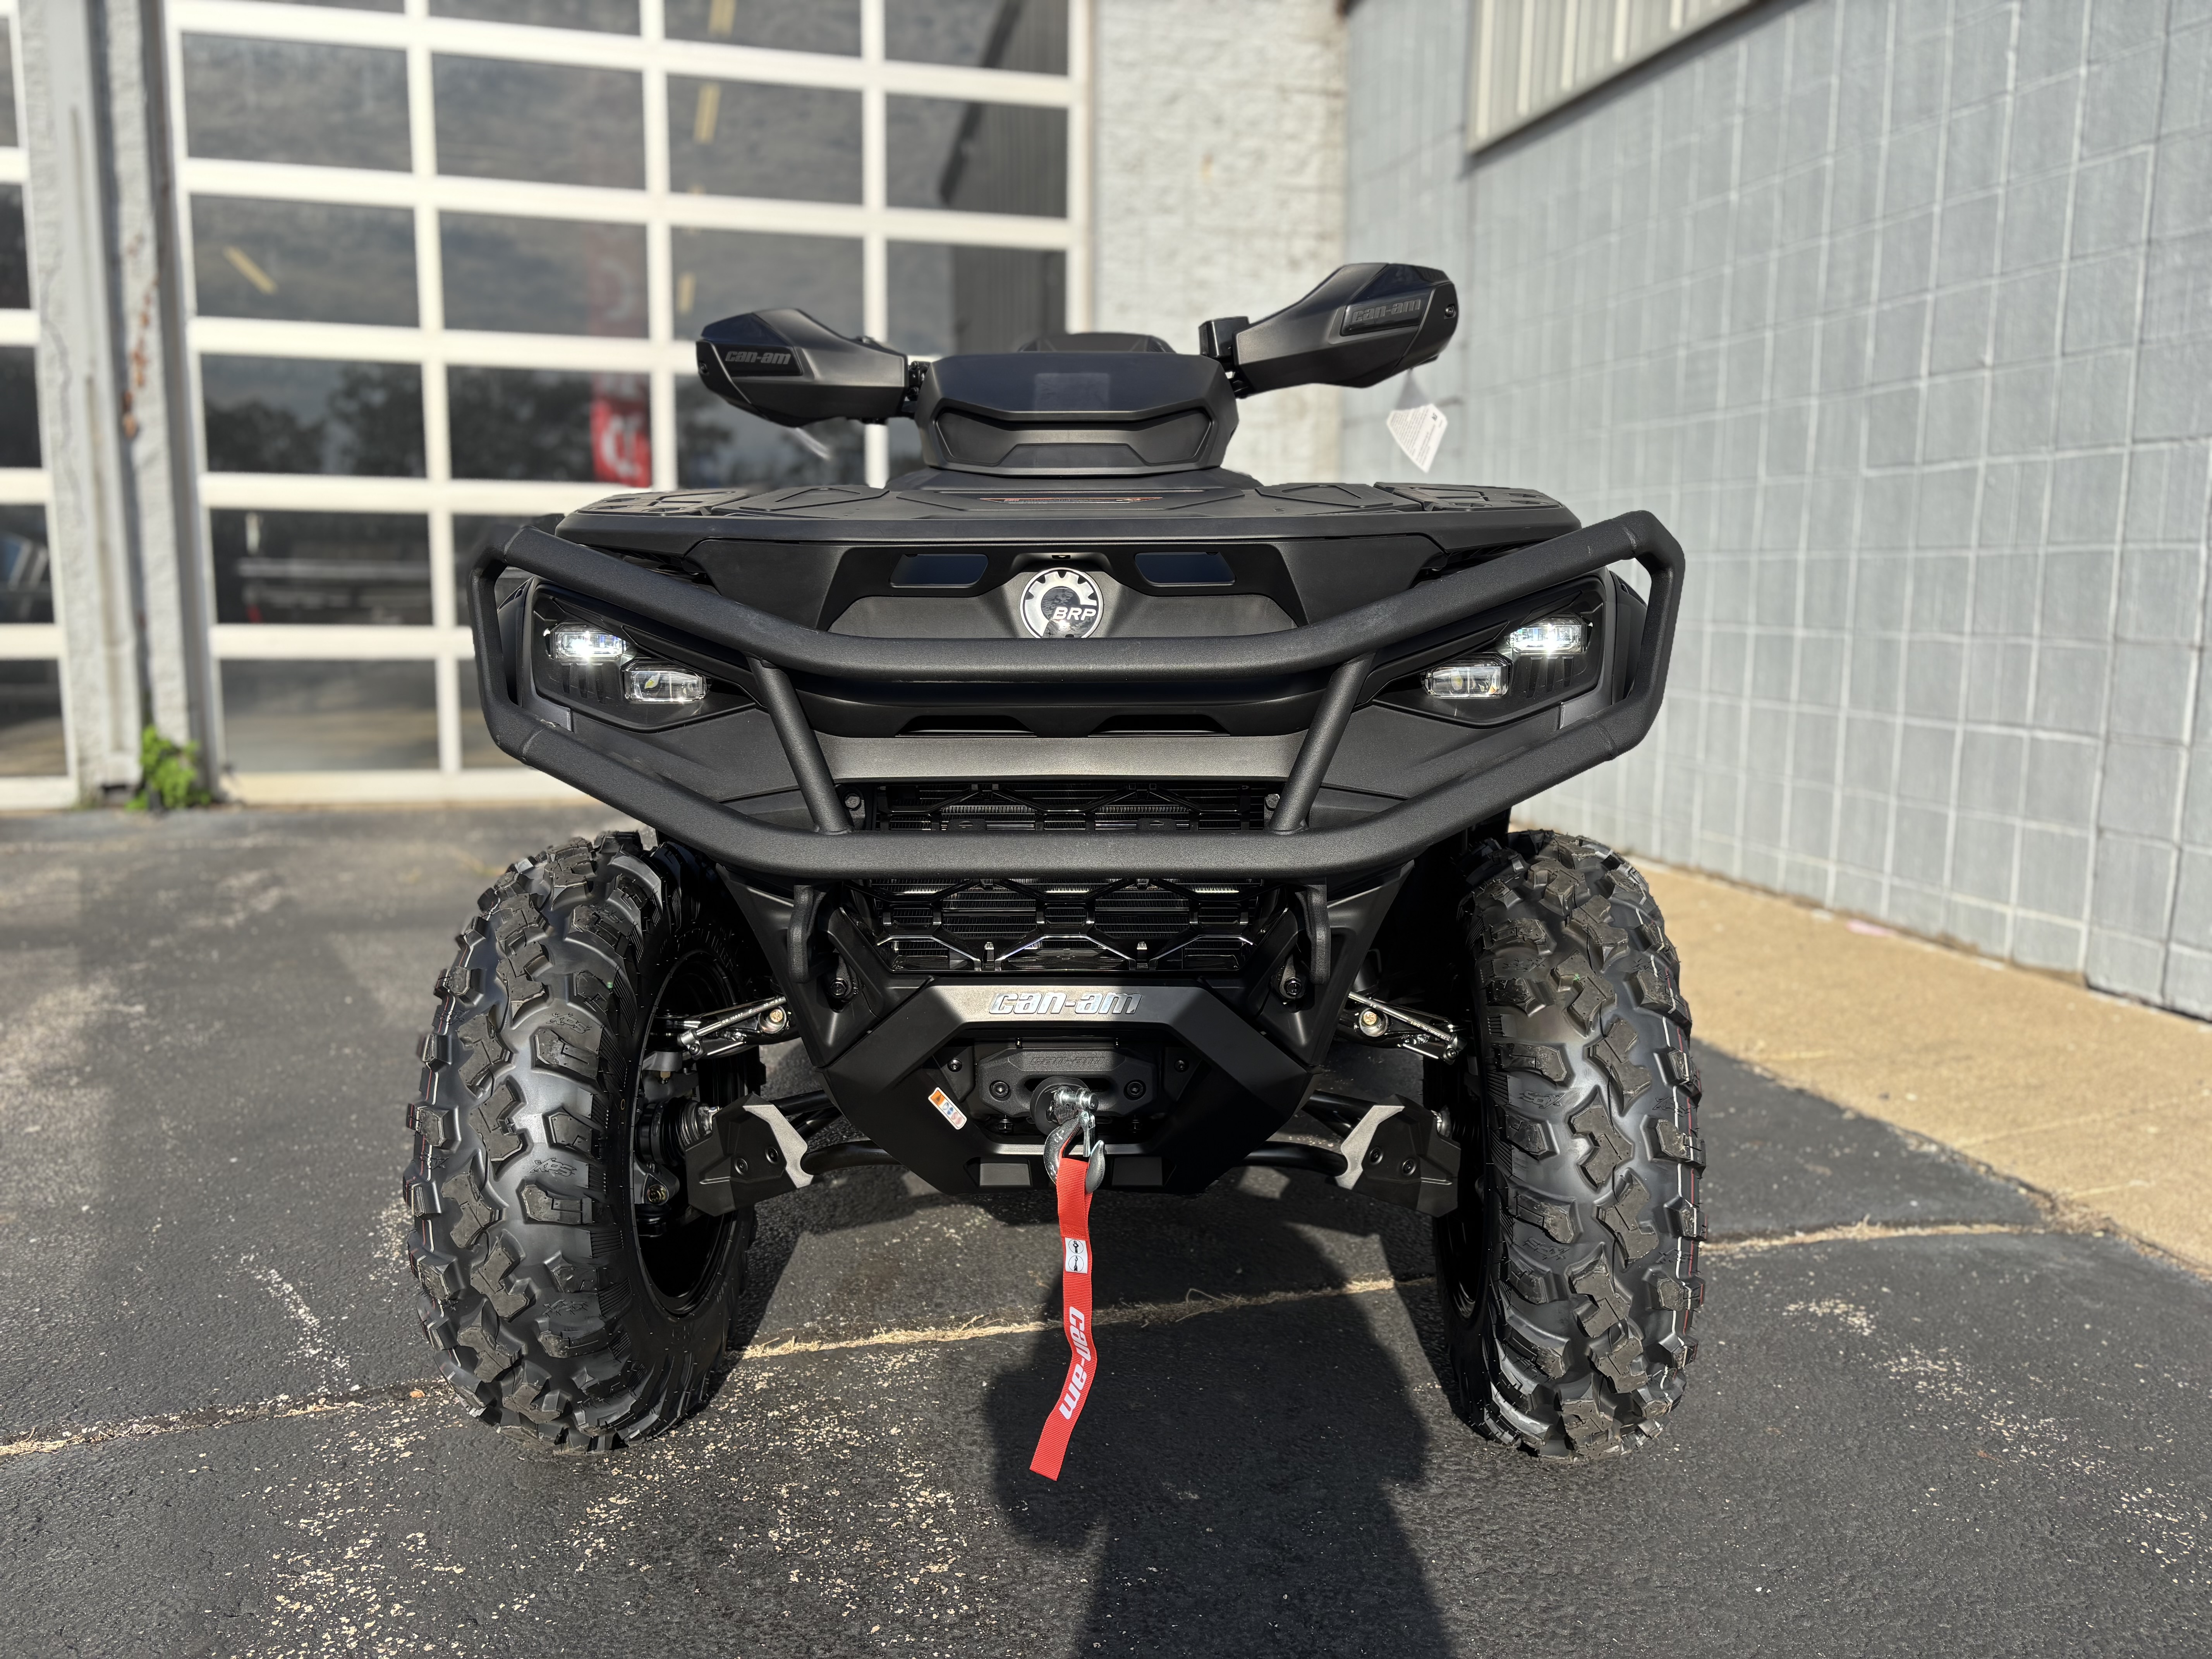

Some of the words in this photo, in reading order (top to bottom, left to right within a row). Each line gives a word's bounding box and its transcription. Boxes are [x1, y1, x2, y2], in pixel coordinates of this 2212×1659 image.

[1352, 298, 1421, 323] can-am
[725, 350, 791, 364] can-am
[1053, 606, 1096, 621] BRP
[989, 993, 1142, 1014] can-am
[1030, 1056, 1106, 1065] can-am
[529, 1158, 577, 1177] XPS
[1058, 1306, 1092, 1420] can-am
